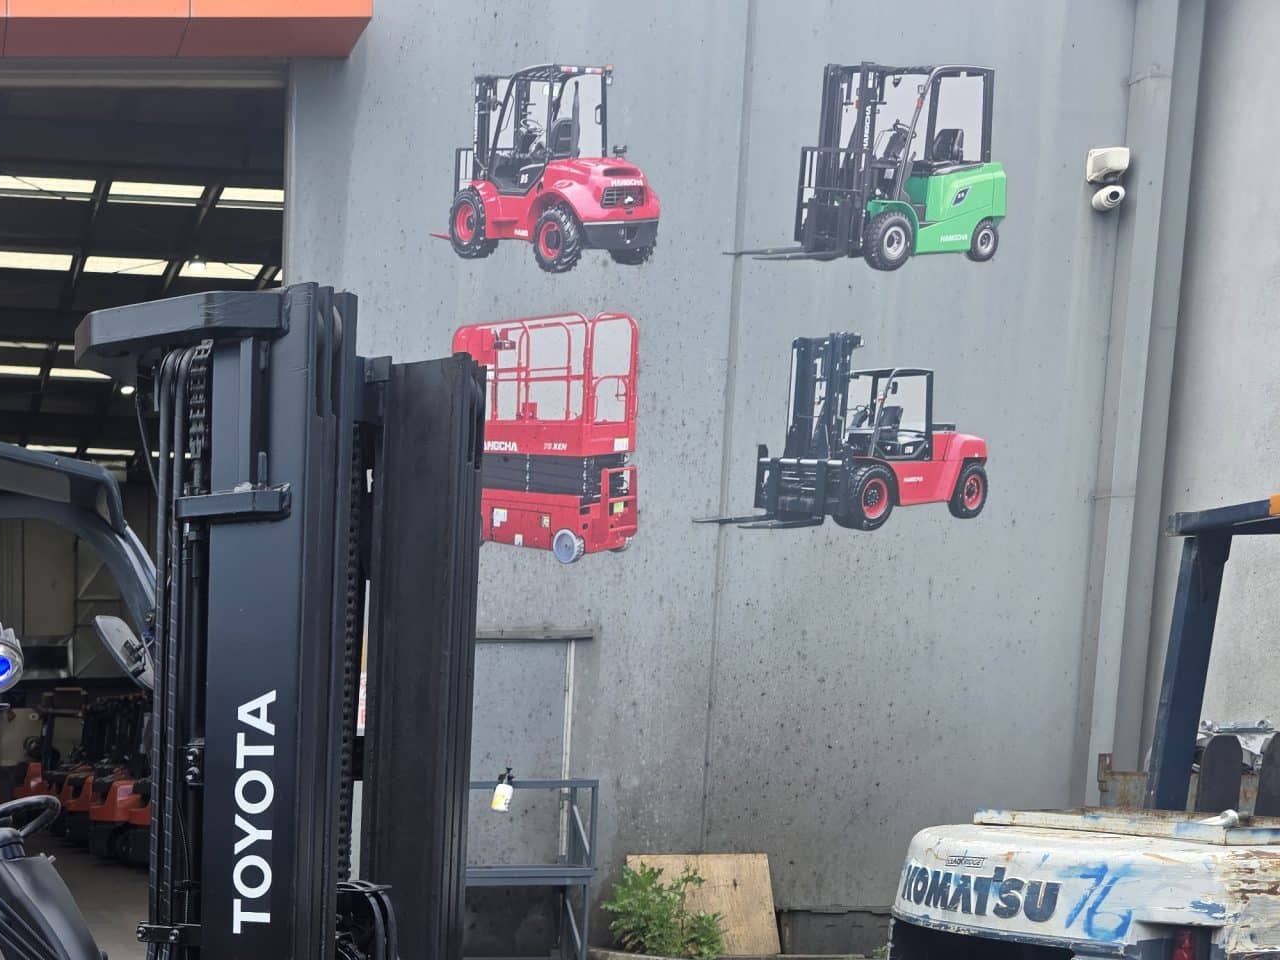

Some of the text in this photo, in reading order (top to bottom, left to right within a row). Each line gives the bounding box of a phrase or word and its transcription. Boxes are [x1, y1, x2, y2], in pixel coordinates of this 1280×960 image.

[483, 440, 518, 451] ANGCHA
[232, 689, 277, 934] TOYOTA
[901, 863, 1062, 923] KOMATSU
